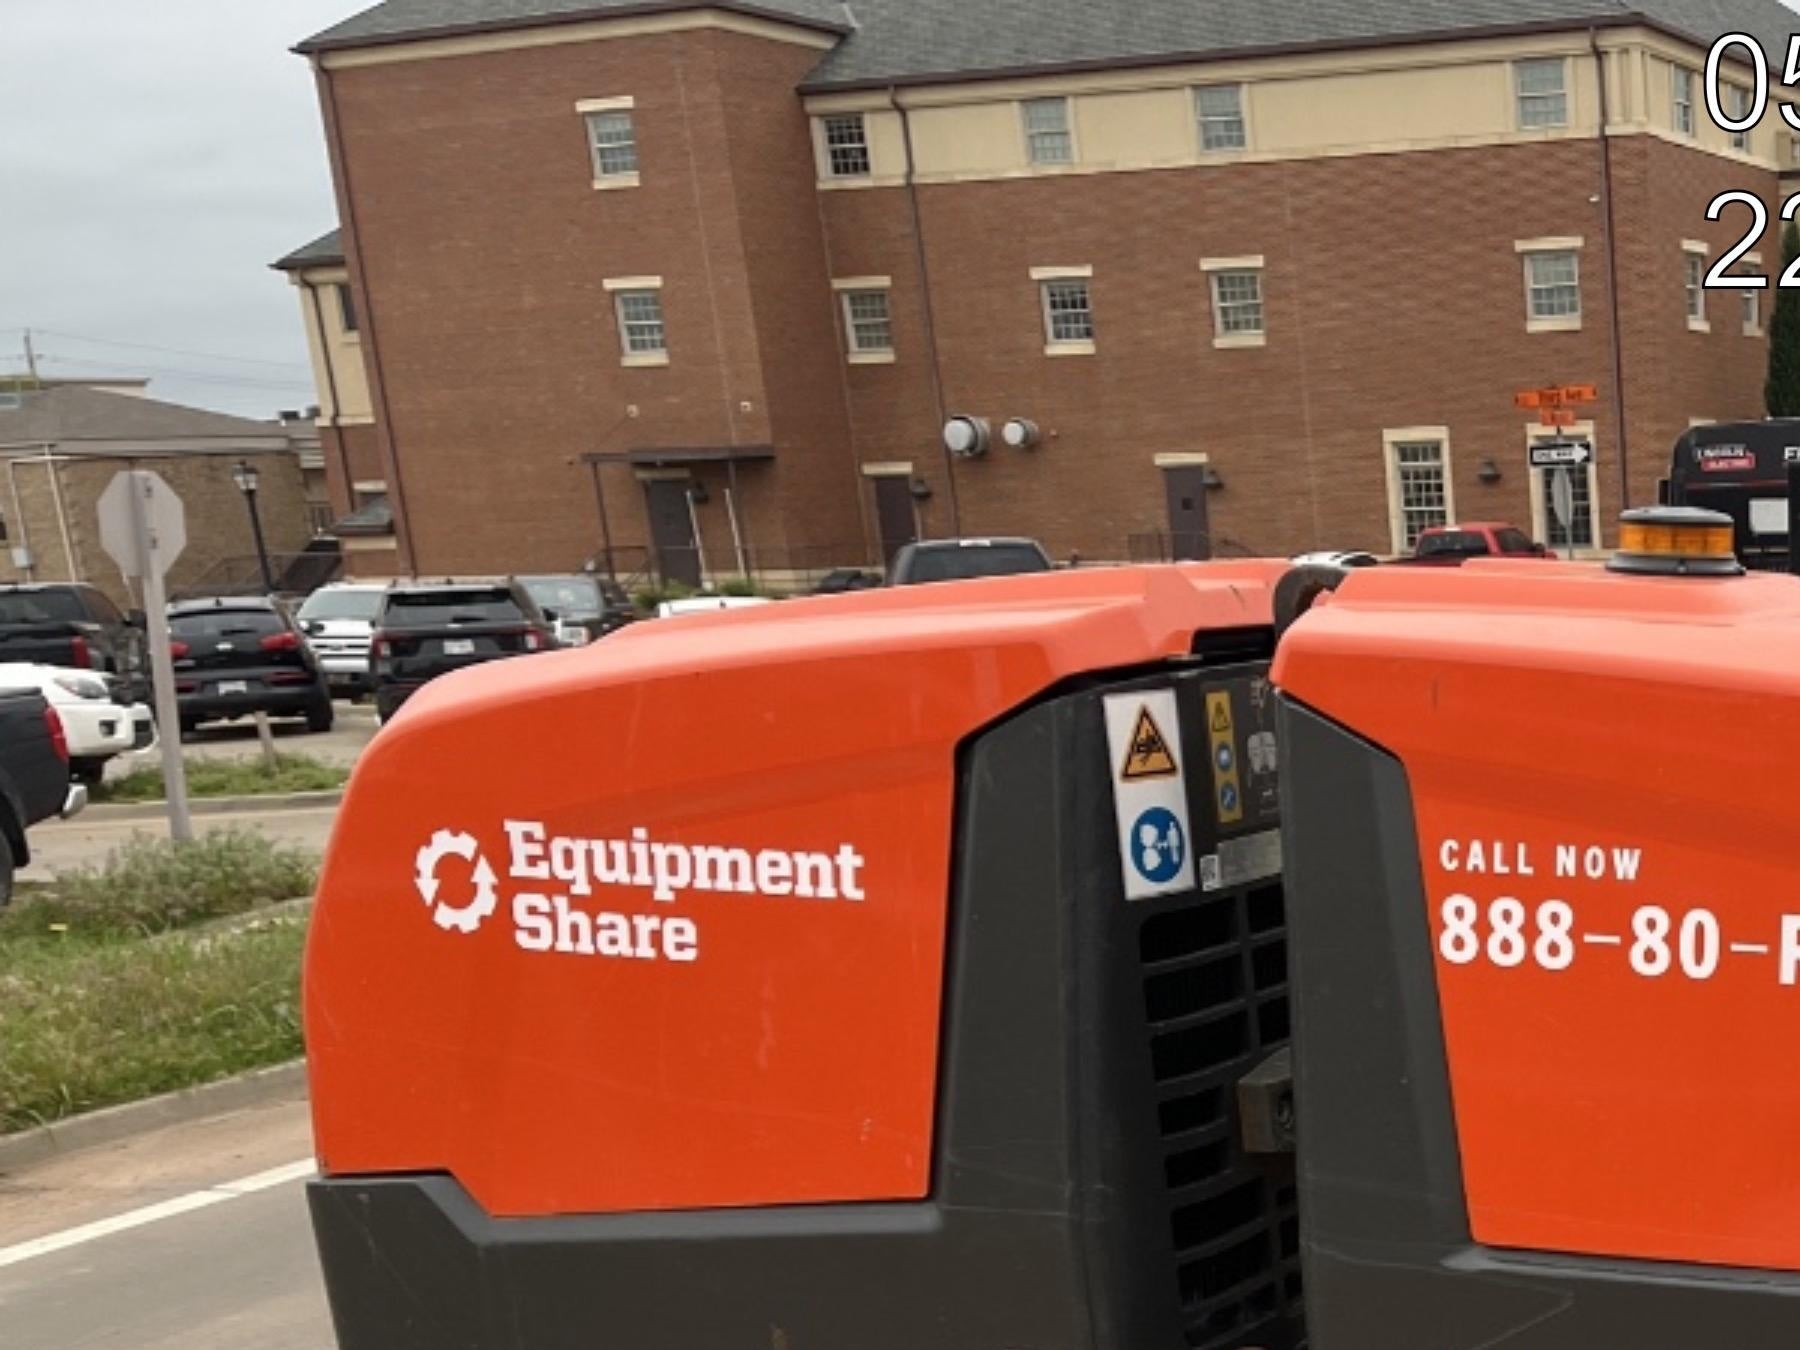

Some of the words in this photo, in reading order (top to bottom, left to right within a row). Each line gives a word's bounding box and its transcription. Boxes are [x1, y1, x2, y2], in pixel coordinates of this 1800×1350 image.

[504, 819, 865, 901] Equipment
[1440, 839, 1535, 875] CALL
[1556, 845, 1642, 880] NOW
[512, 893, 697, 961] Share
